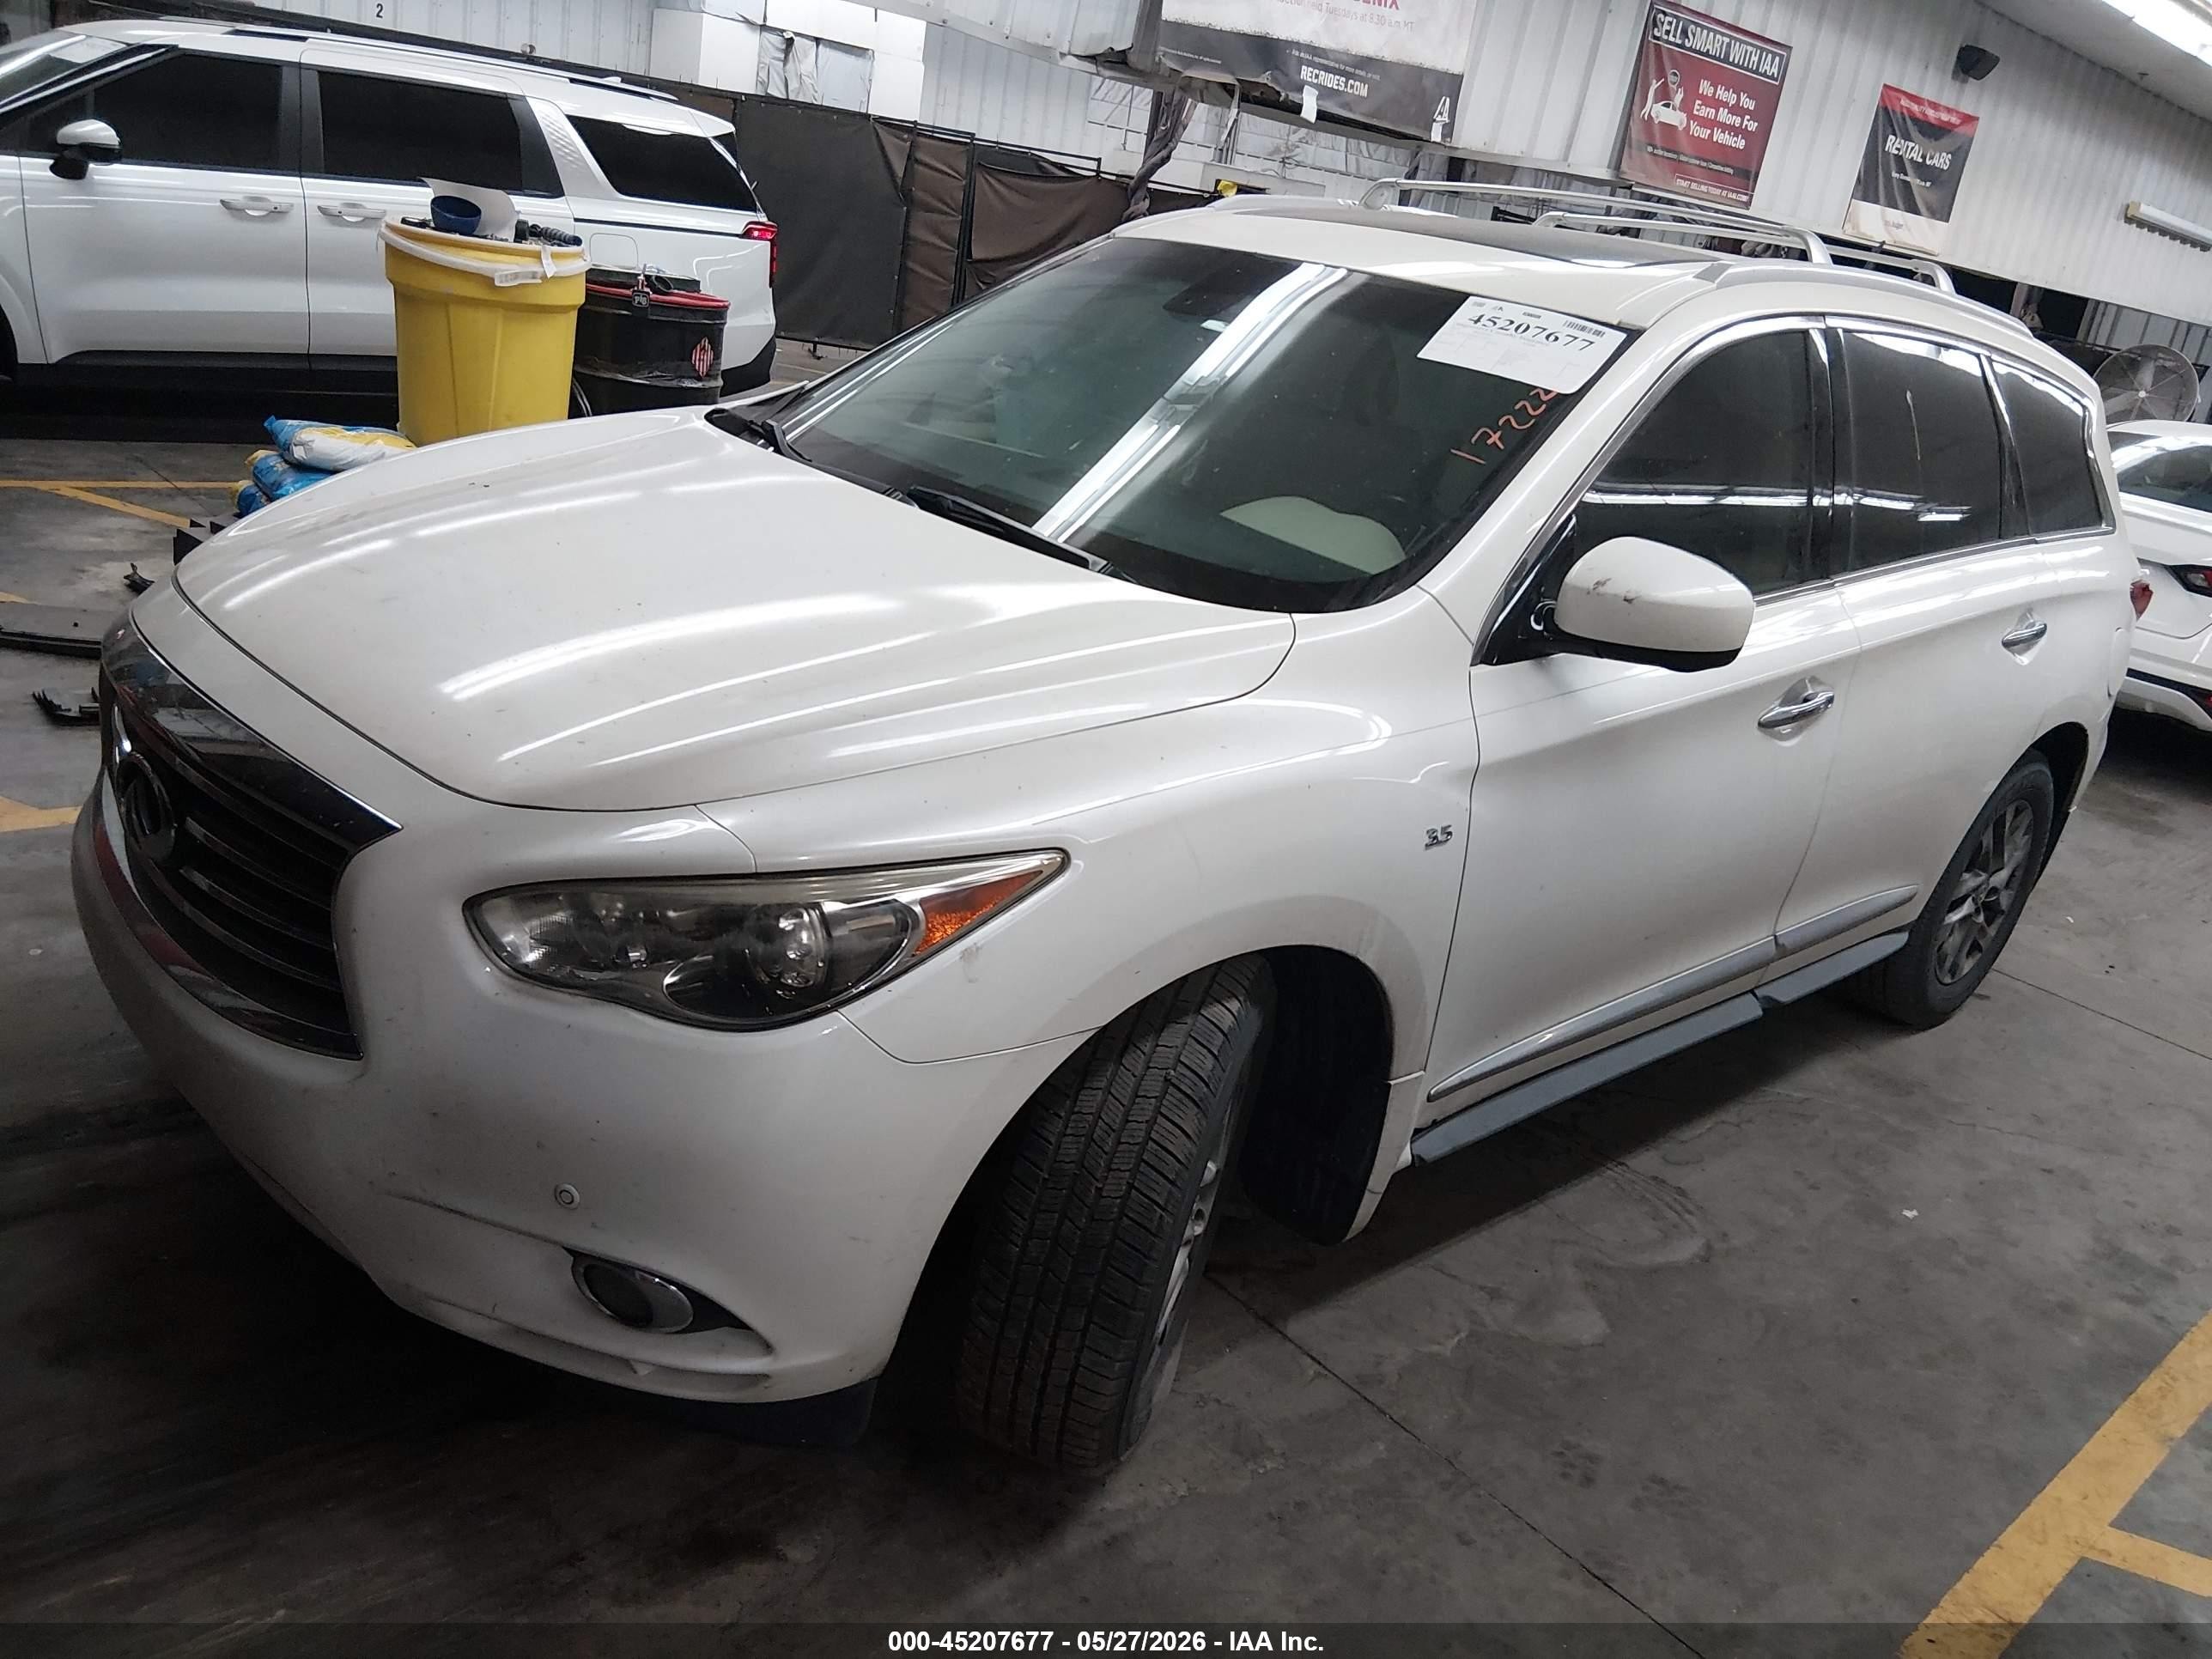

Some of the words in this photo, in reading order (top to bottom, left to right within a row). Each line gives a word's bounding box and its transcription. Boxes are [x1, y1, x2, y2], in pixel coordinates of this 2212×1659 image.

[376, 3, 384, 18] 2
[1653, 13, 1684, 44] SELL
[1685, 24, 1730, 59] SMART
[1729, 40, 1759, 70] WITH
[1759, 52, 1780, 78] IAA
[1300, 65, 1368, 98] RECRIDES.COM
[1698, 78, 1715, 97] We
[1716, 84, 1737, 107] Help
[1739, 91, 1756, 111] You
[1692, 100, 1716, 119] Earn
[1717, 107, 1741, 127] More
[1741, 115, 1759, 132] For
[1689, 119, 1711, 140] Your
[1712, 127, 1746, 149] Vehicle
[1885, 134, 1923, 163] RENTAL
[1925, 149, 1952, 170] CARS
[1468, 313, 1596, 351] 45207677
